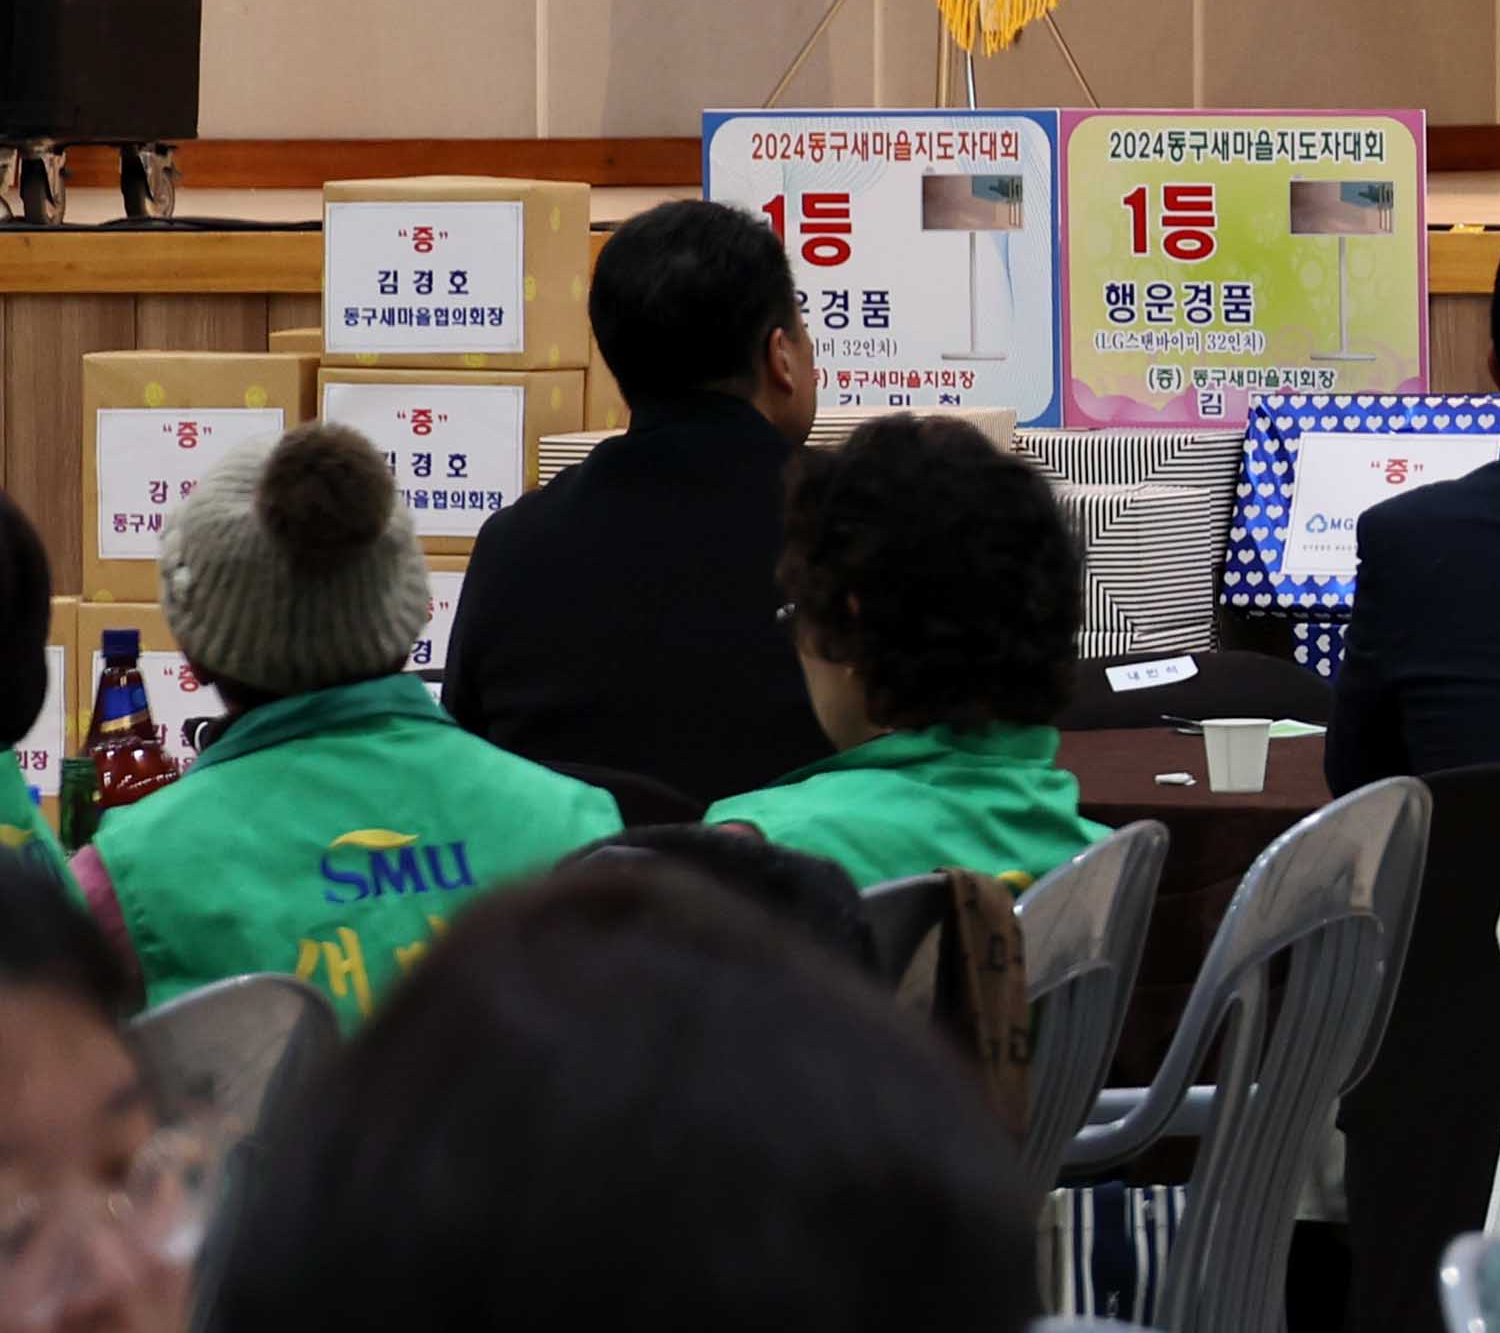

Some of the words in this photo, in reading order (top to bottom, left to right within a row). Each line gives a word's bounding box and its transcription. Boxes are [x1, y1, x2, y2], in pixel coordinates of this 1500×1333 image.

[751, 130, 1019, 162] 2024동구새마을지도자대회
[1109, 129, 1384, 163] 2024동구새마을지도자대회
[762, 192, 853, 268] 1등
[1123, 185, 1215, 261] 1등
[343, 306, 505, 327] 동구새마을협의회장
[1105, 283, 1253, 324] 행운경품
[836, 370, 976, 389] 동구새마을지회장
[1193, 369, 1336, 389] 동구새마을지회장
[320, 840, 476, 903] SMU
